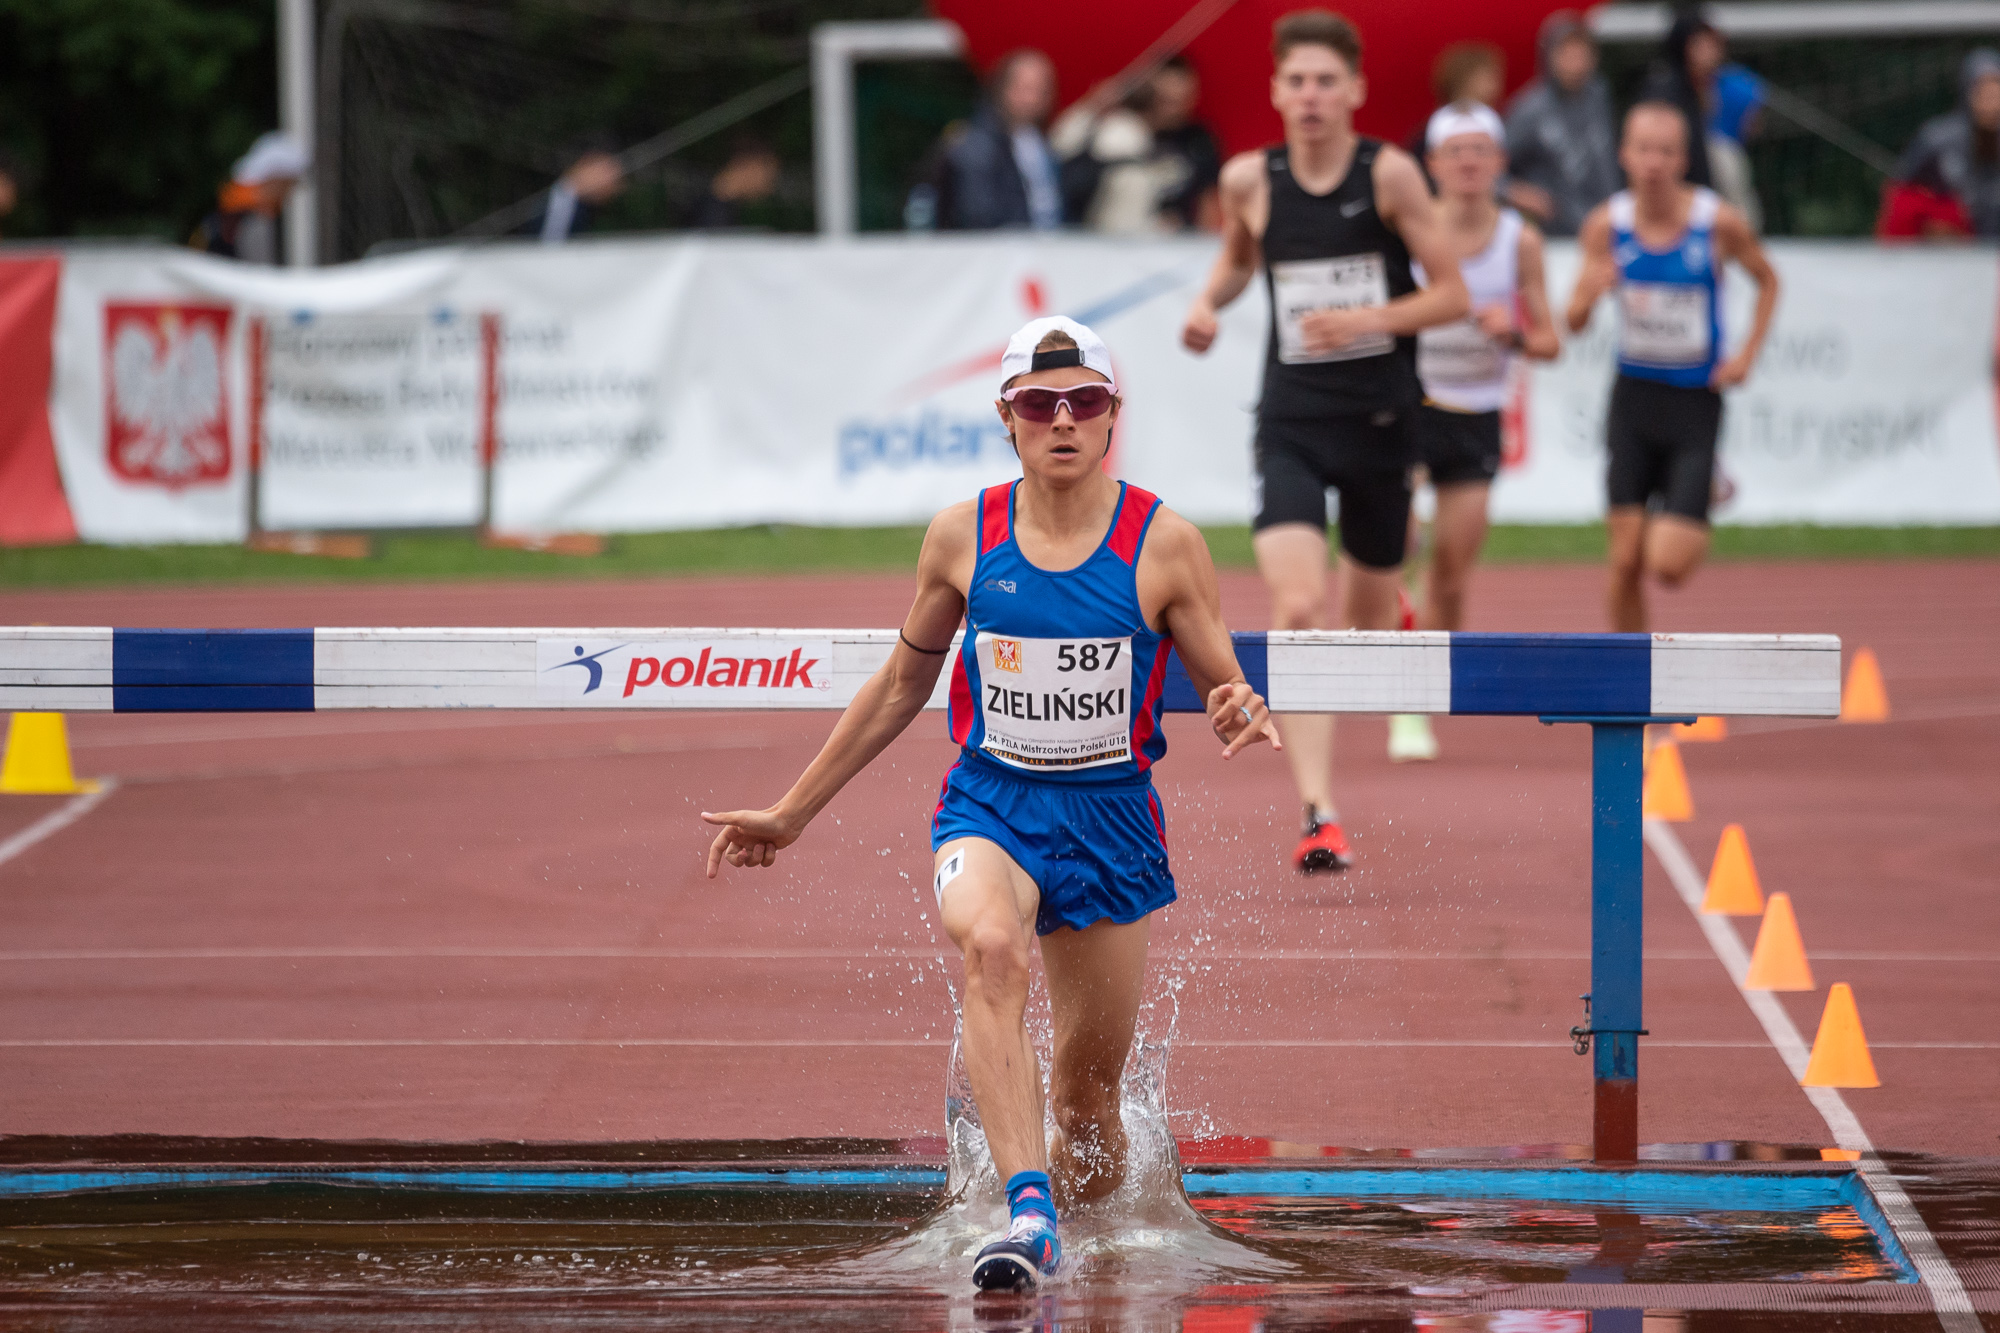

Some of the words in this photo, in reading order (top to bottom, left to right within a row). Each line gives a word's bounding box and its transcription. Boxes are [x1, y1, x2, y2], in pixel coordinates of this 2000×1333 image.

[622, 646, 819, 699] polanik
[1057, 642, 1121, 672] 587
[987, 683, 1125, 721] ZIELIŃSKI
[988, 733, 999, 744] 54.
[1001, 737, 1019, 750] PZLA
[1021, 743, 1077, 755] Mistrzostwa
[1080, 739, 1107, 753] Polski
[1109, 735, 1127, 747] U18
